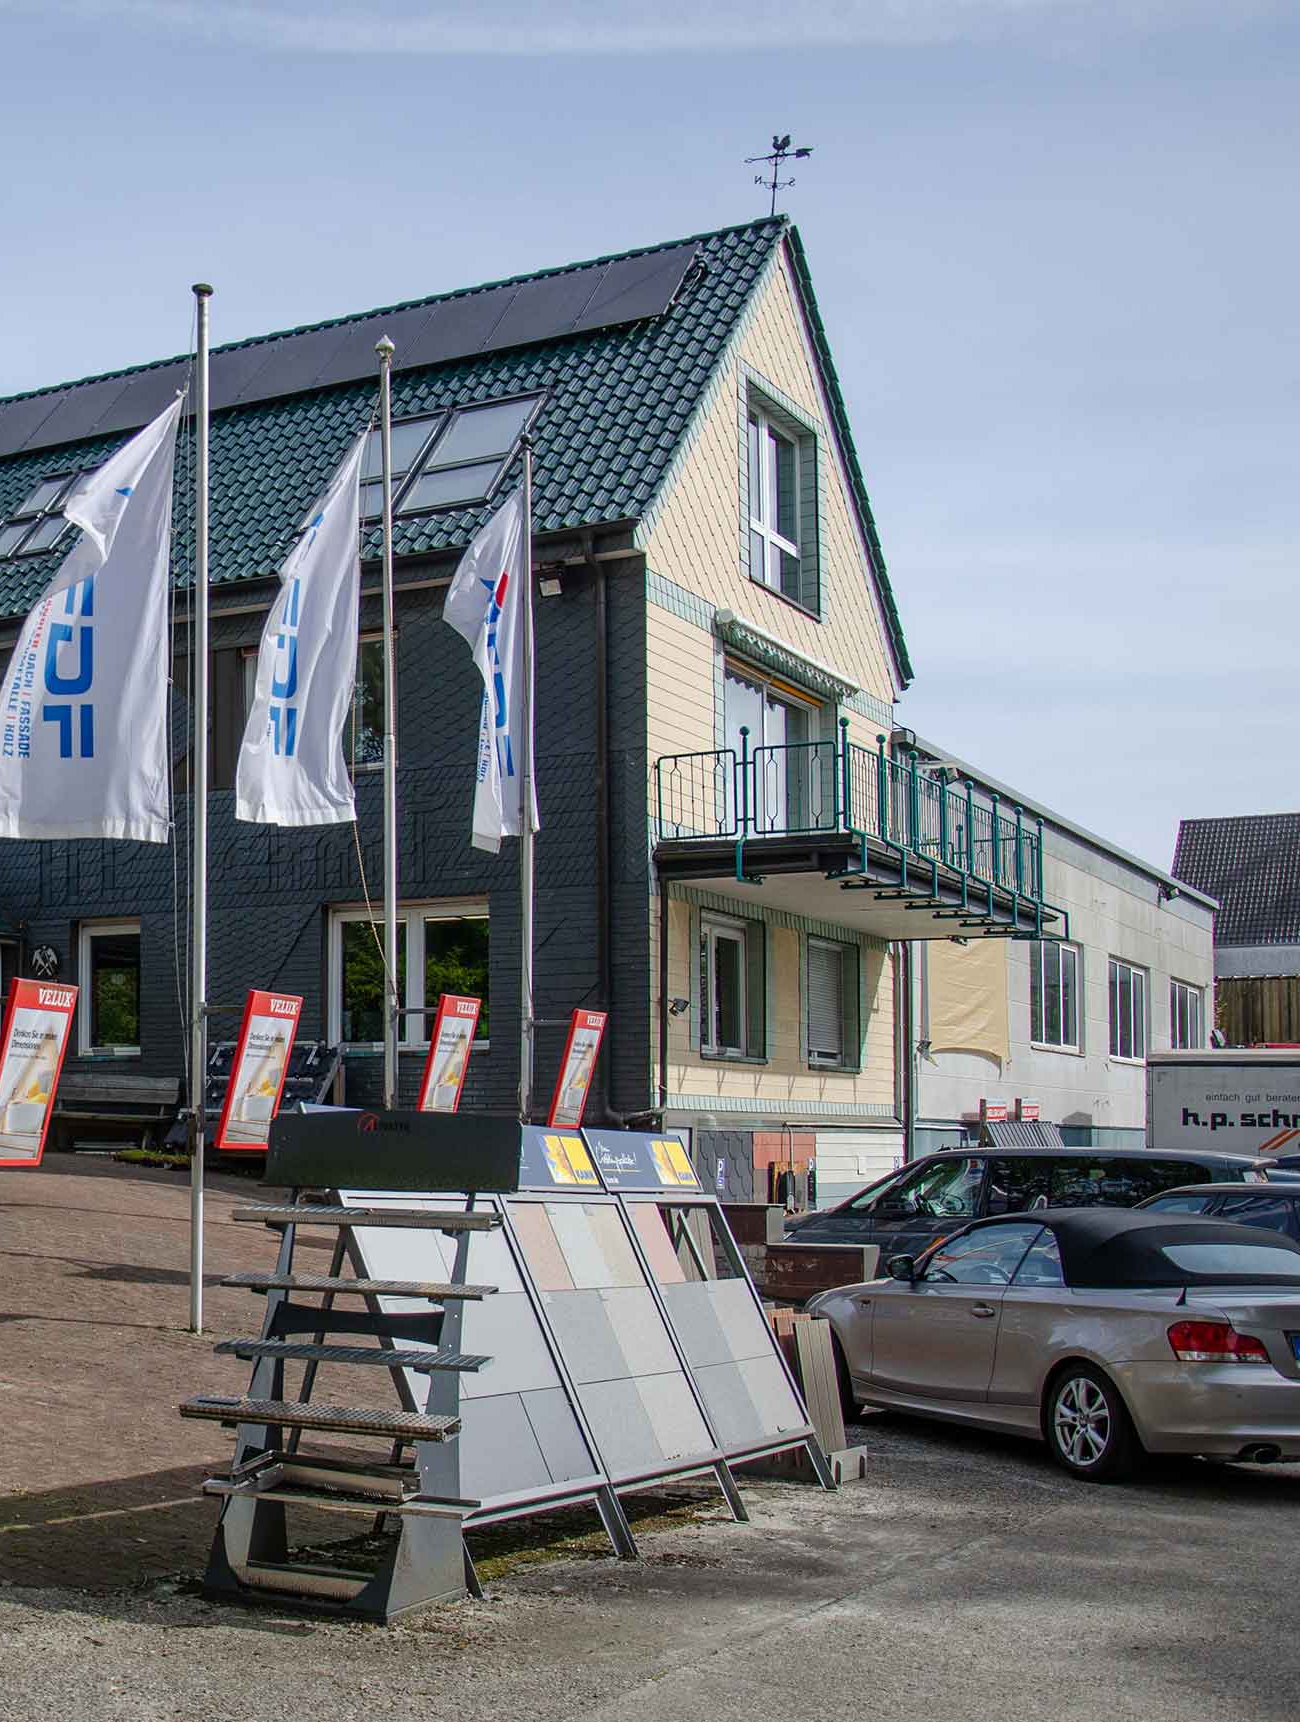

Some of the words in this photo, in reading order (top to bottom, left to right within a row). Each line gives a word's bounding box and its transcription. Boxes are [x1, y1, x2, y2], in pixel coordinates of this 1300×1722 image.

[25, 653, 37, 688] DACH
[3, 723, 15, 757] HOLZ
[18, 701, 30, 758] FASSADE
[38, 988, 73, 1007] VELUX
[270, 998, 299, 1015] VELUX
[457, 1001, 476, 1015] VELUX
[1206, 1091, 1240, 1102] einfach
[1245, 1092, 1261, 1104] gut
[1182, 1107, 1235, 1131] h.p.
